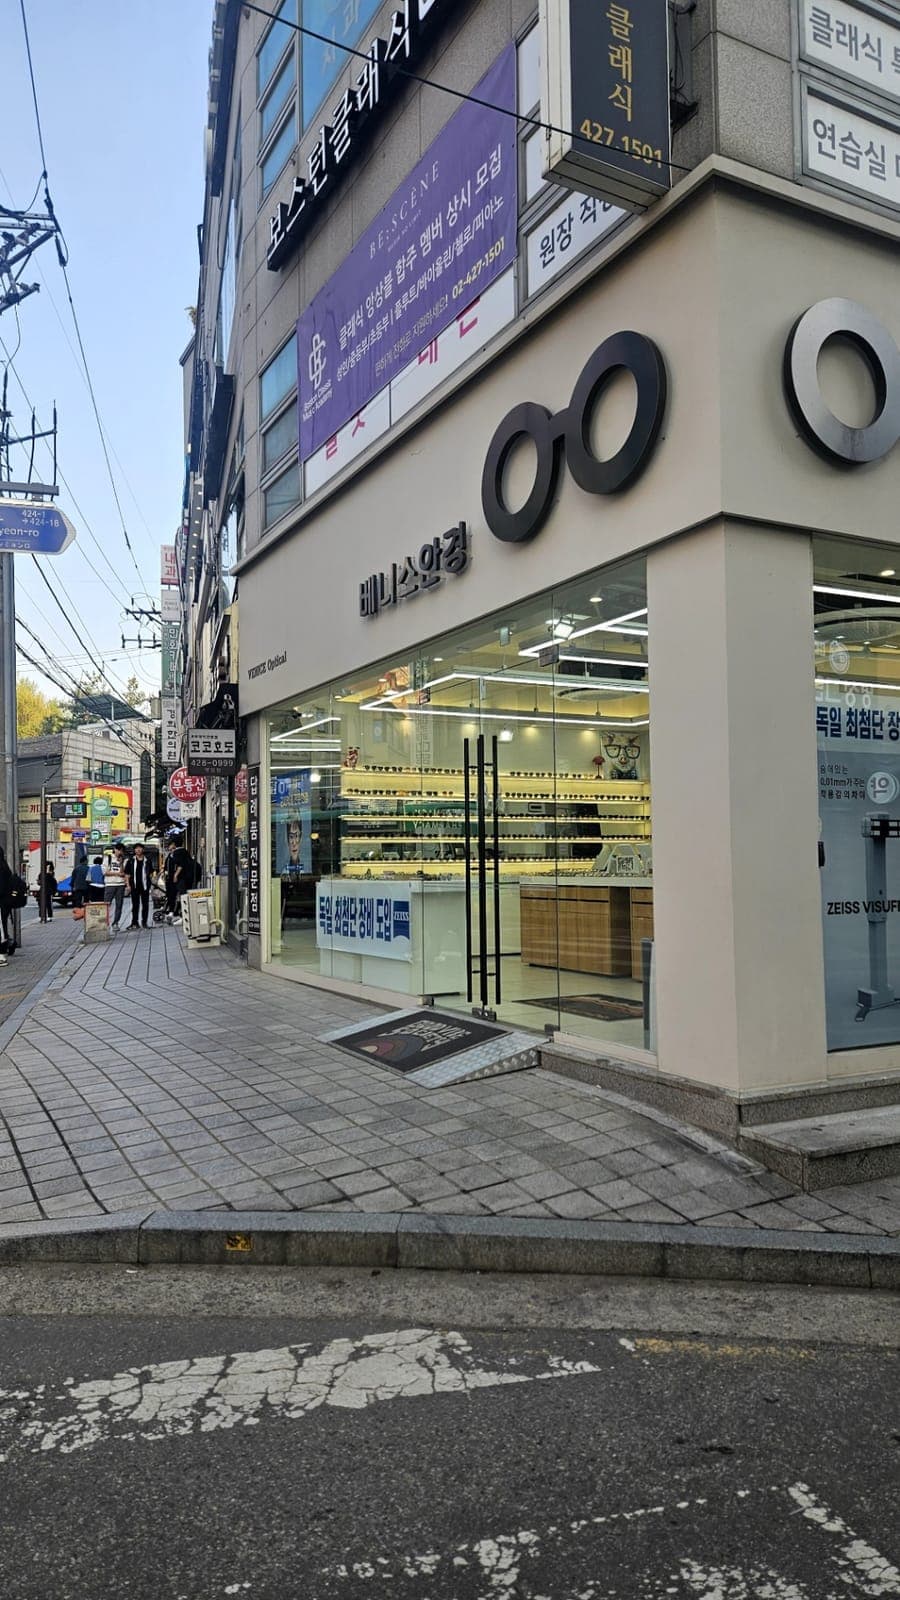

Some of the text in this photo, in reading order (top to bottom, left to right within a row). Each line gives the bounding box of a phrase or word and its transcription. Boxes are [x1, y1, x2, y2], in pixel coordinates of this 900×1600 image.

[606, 3, 633, 122] 클래식
[809, 6, 882, 73] 클래식
[813, 119, 887, 181] 연습실
[339, 306, 363, 350] 클래식
[366, 270, 393, 318] 앙상블
[396, 244, 418, 284] 합주
[420, 212, 443, 257] 멤버
[447, 180, 471, 226] 상시
[475, 143, 502, 194] 모집
[540, 196, 612, 269] 원장 직
[452, 236, 505, 299] 02-427-1501
[22, 509, 46, 518] 424-1
[359, 521, 467, 617] 베니스안경
[267, 650, 287, 671] Optical
[816, 706, 842, 738] 독일
[846, 707, 885, 740] 최첨단
[190, 741, 234, 753] 코코호도
[172, 777, 206, 792] 부동산
[319, 895, 392, 942] 독일 최첨단 장비 도입
[393, 911, 409, 921] ZEISS
[827, 900, 860, 915] ZEISS
